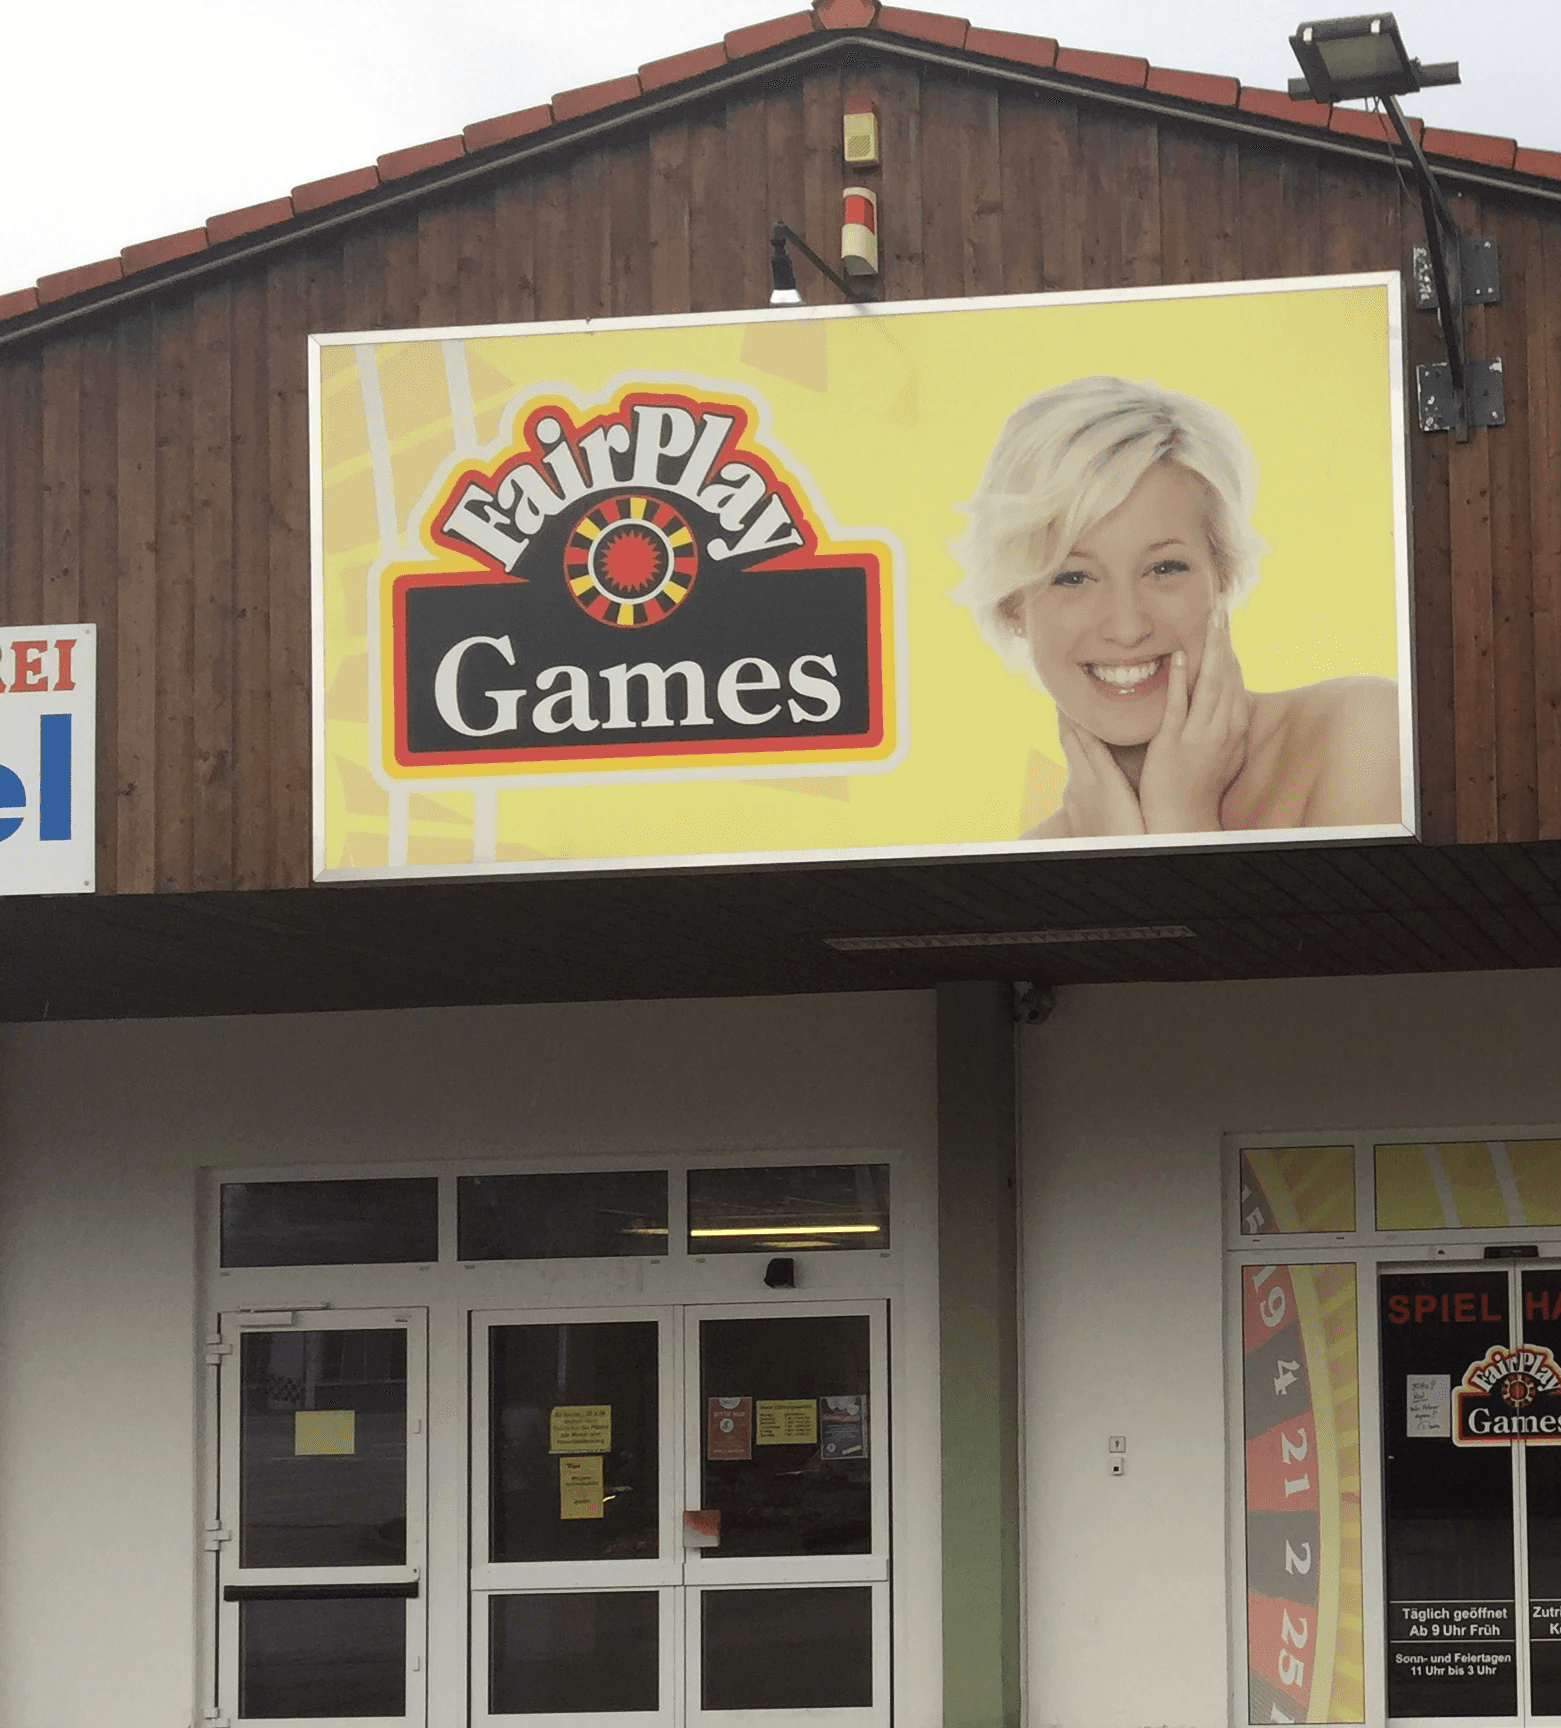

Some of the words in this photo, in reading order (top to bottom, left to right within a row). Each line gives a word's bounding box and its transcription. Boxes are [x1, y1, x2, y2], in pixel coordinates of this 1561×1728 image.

[442, 405, 804, 573] FairPlay
[0, 638, 77, 694] EI
[433, 634, 841, 737] Games
[1387, 1292, 1502, 1325] SPIEL
[1273, 1359, 1300, 1396] 4
[1281, 1427, 1311, 1498] 21
[1284, 1539, 1312, 1575] 2
[1402, 1607, 1450, 1622] Täglich
[1453, 1606, 1508, 1622] geöffnet
[1409, 1624, 1428, 1636] Ab
[1431, 1624, 1440, 1636] 9
[1443, 1624, 1467, 1636] Uhr
[1470, 1623, 1501, 1636] Früh
[1278, 1607, 1309, 1688] 25
[1395, 1653, 1429, 1664] Sonn-
[1430, 1652, 1452, 1663] und
[1454, 1652, 1512, 1665] Feiertagen
[1410, 1665, 1422, 1676] 11
[1425, 1665, 1446, 1676] Uhr
[1448, 1665, 1465, 1676] bis
[1467, 1665, 1475, 1676] 3
[1477, 1665, 1498, 1676] Uhr
